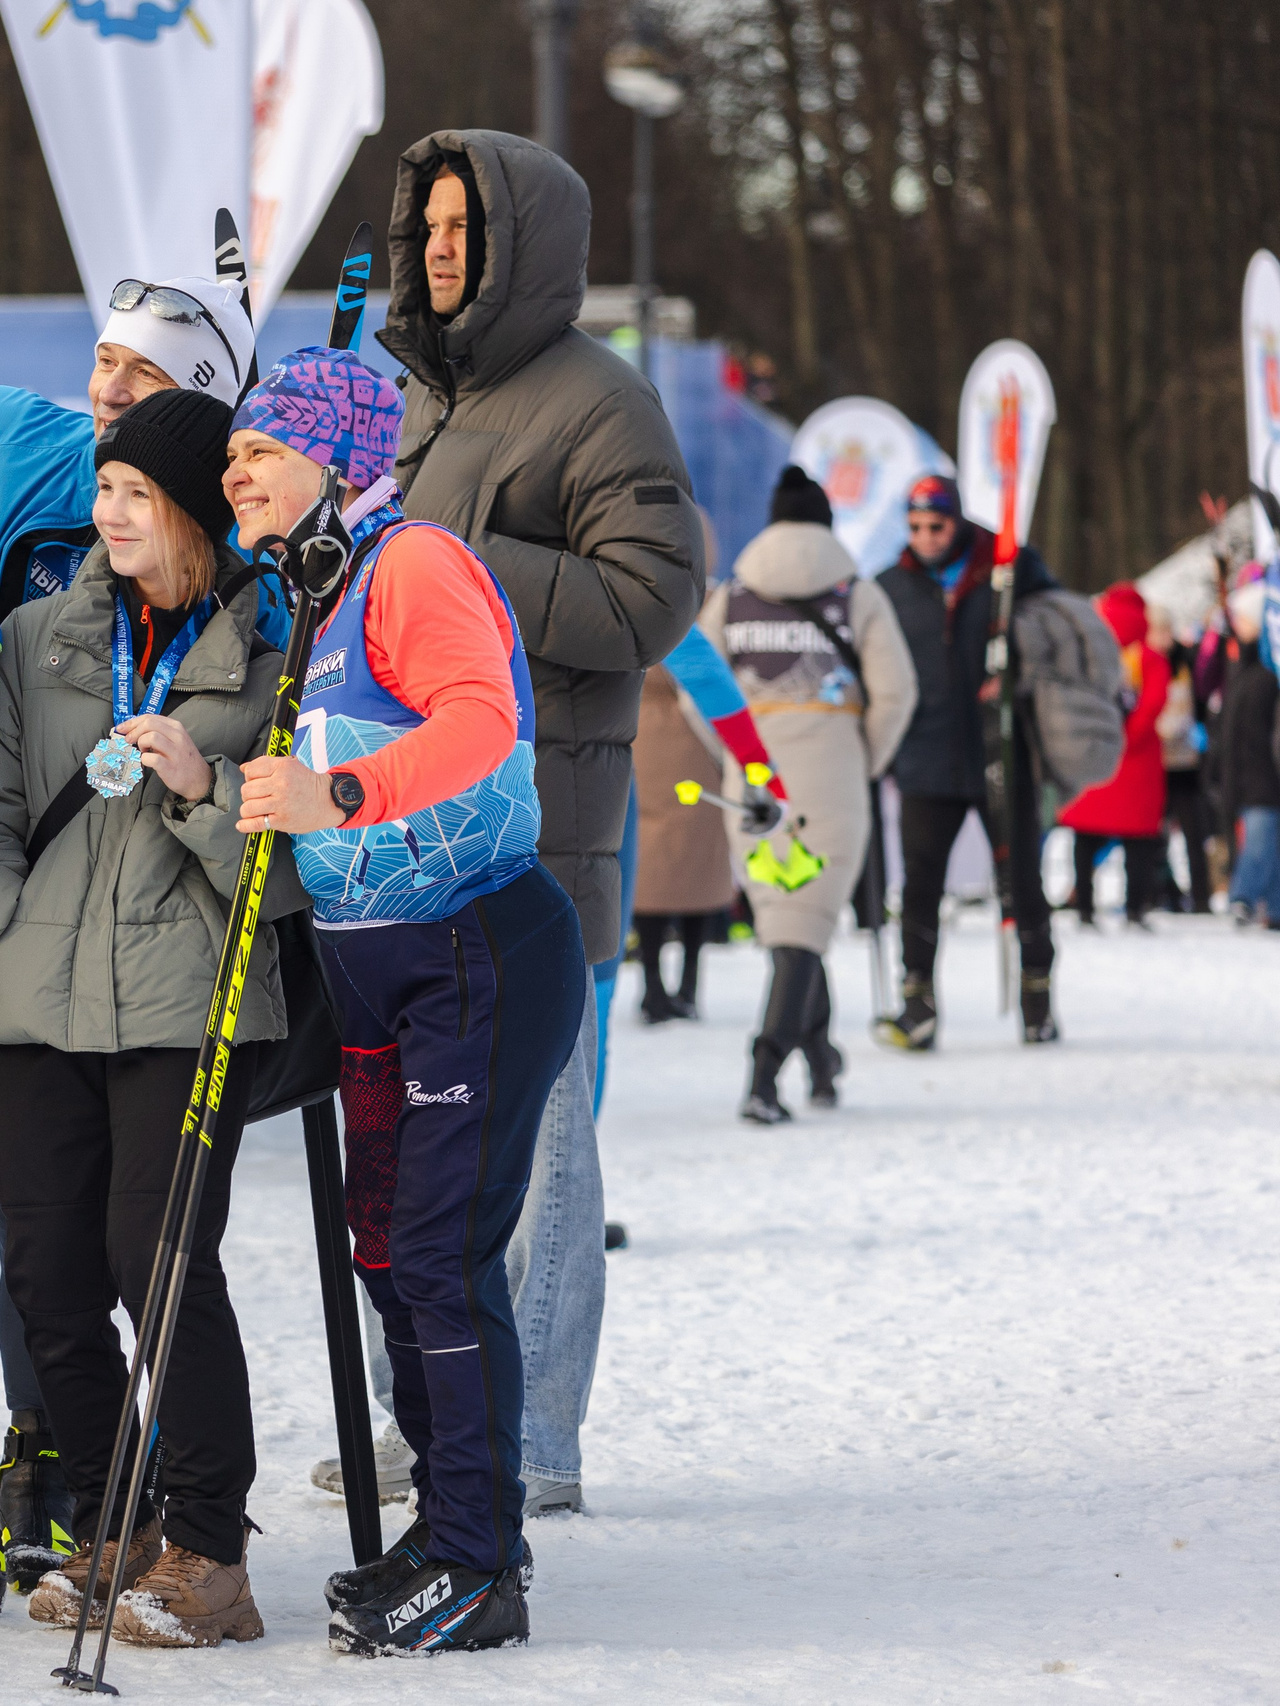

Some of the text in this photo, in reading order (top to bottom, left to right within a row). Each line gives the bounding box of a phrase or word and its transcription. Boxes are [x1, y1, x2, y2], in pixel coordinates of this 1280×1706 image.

[117, 637, 128, 680] ГУБЕРНАТОРА
[148, 678, 167, 706] ЯНВАРЯ
[91, 777, 100, 785] 19
[150, 1464, 159, 1488] CARBON
